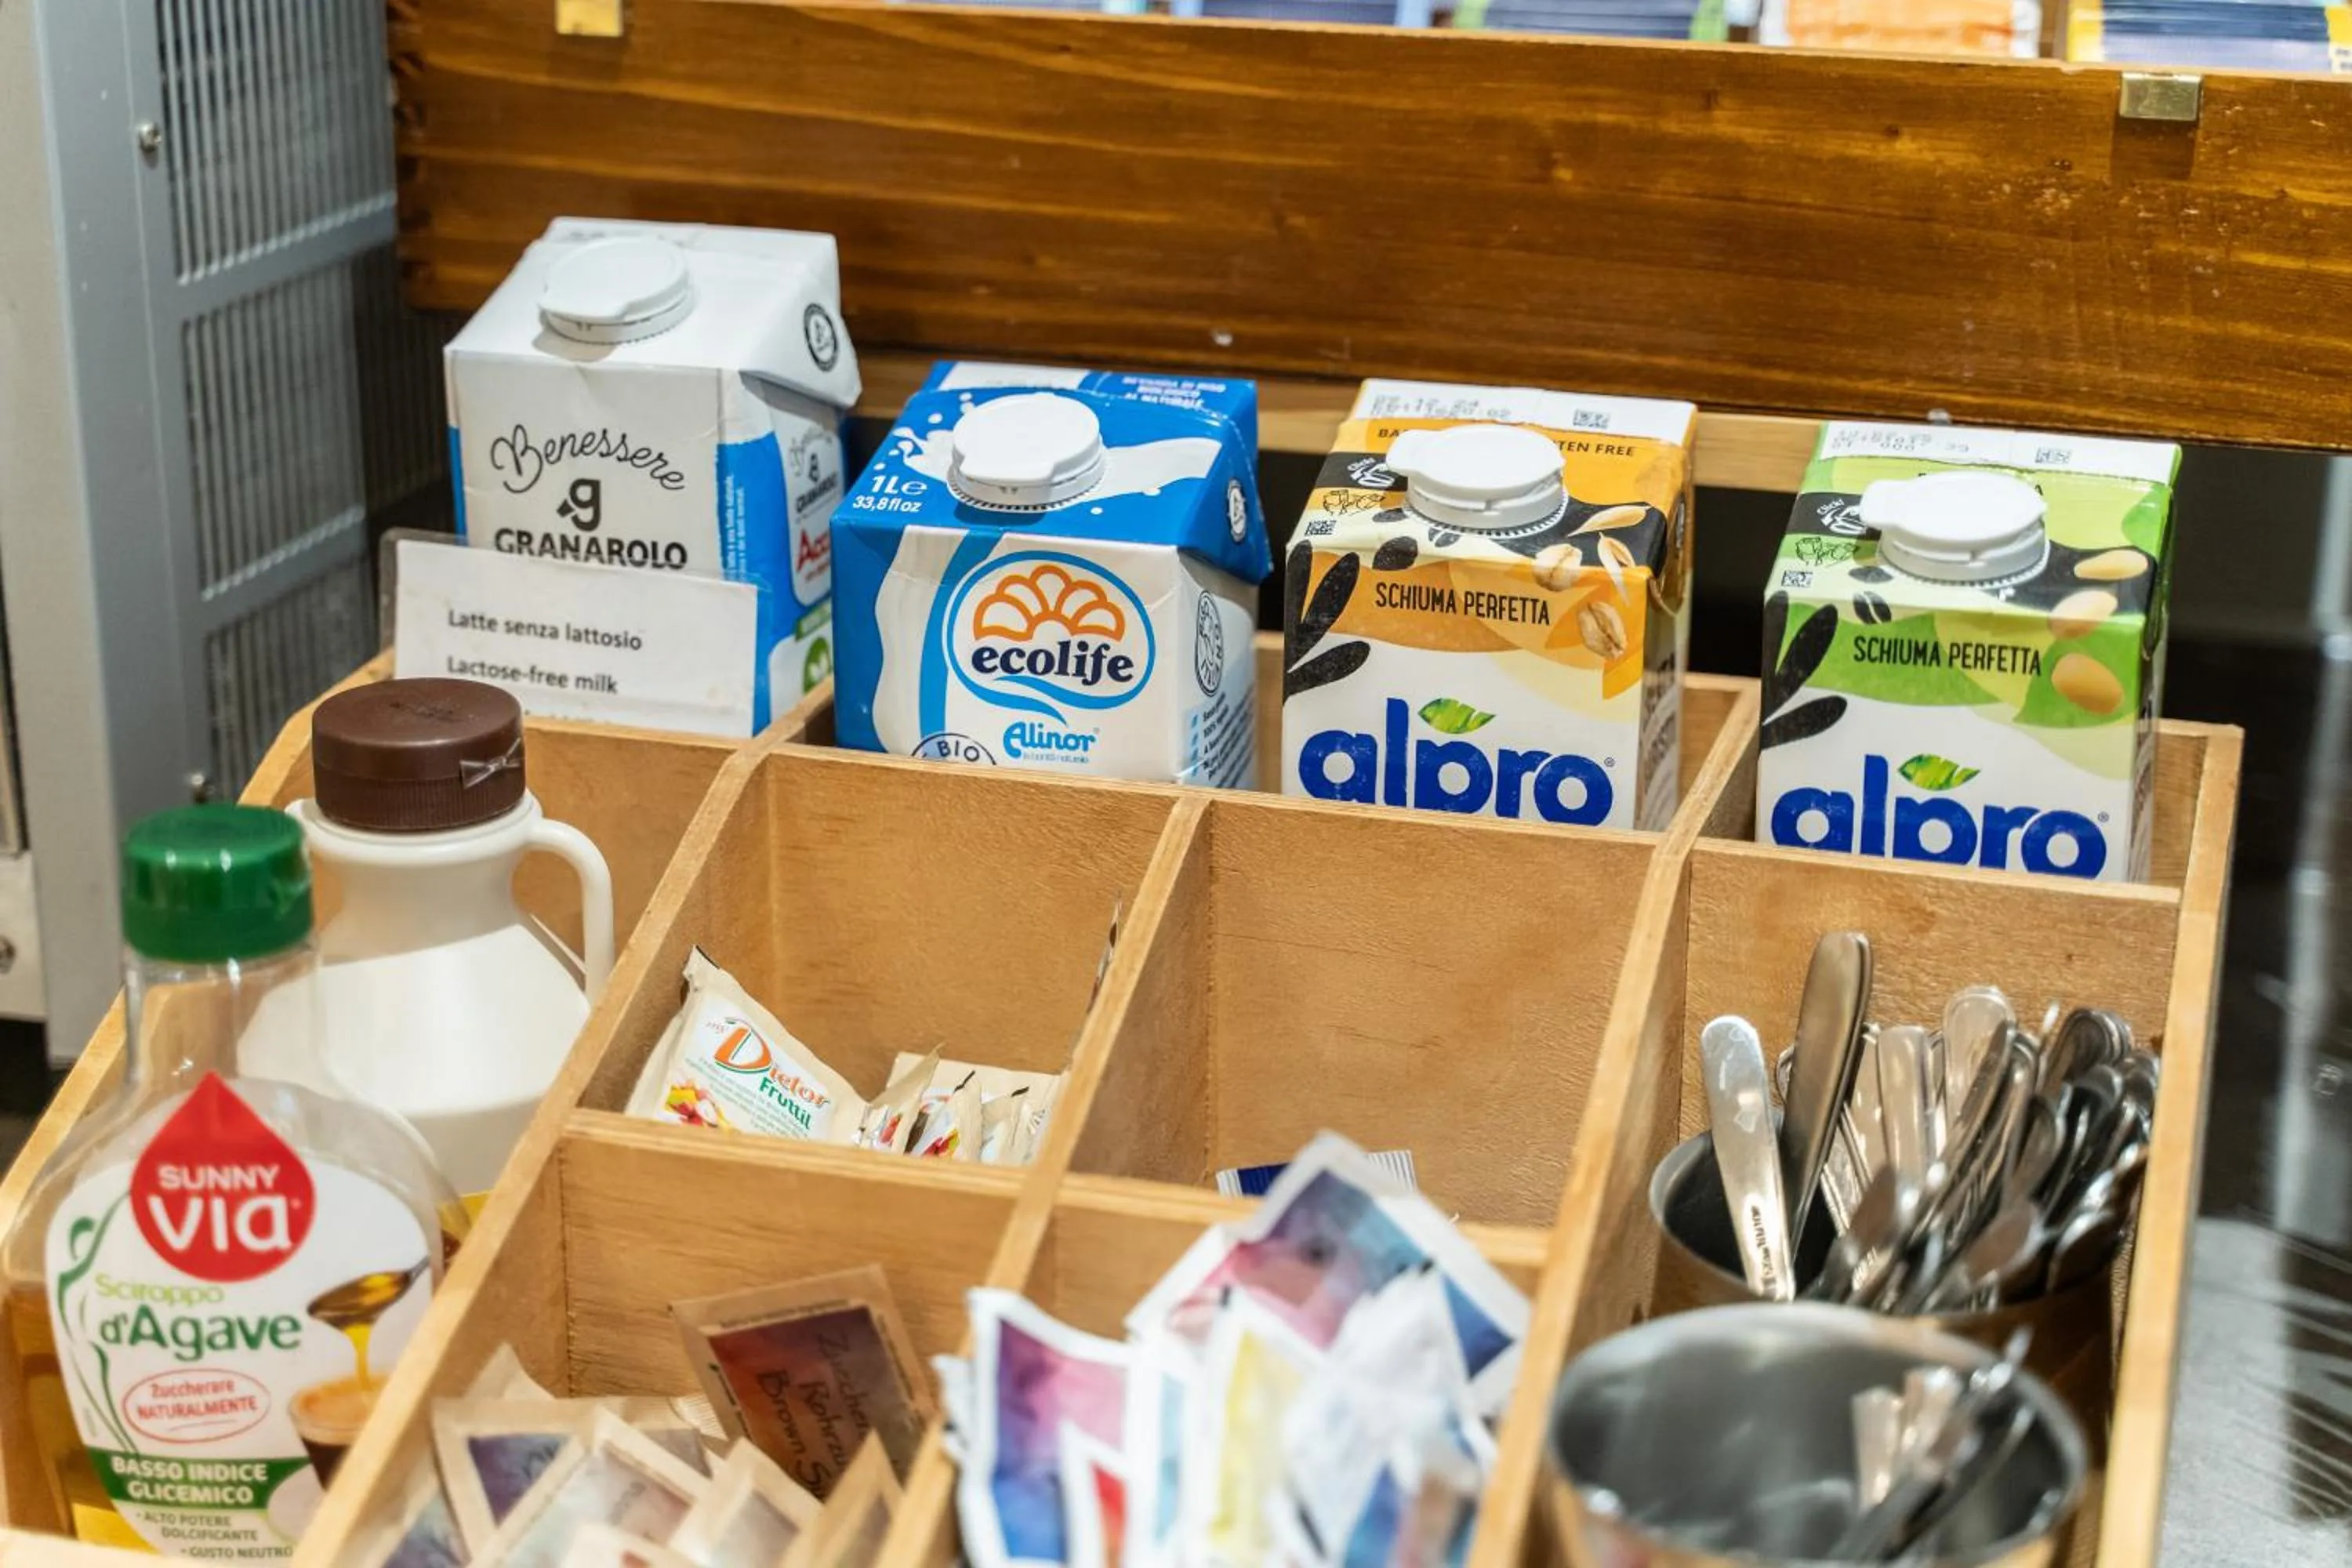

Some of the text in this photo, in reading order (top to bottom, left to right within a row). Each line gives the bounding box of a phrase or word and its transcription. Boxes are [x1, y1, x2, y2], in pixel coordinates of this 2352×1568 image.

[490, 423, 685, 493] Benessere
[1595, 443, 1637, 456] FREE
[495, 528, 688, 570] GRANAROLO
[1375, 582, 1550, 626] SCHIUMA PERFETTA
[448, 608, 643, 651] Latte senza lattosio
[447, 655, 619, 695] Lactose-free milk
[971, 640, 1134, 686] ecolife
[1853, 636, 2042, 677] SCHIUMA PERFETTA
[937, 740, 980, 763] BIO
[1003, 720, 1096, 758] Alinor
[1298, 698, 1613, 826] alpro
[1771, 753, 2107, 880] alpro
[158, 1163, 281, 1191] SUNNY
[94, 1273, 224, 1306] Sciroppo
[100, 1304, 302, 1362] d'Agave
[136, 1395, 258, 1420] NATURALMENTE
[757, 1369, 806, 1454] Brown
[111, 1456, 268, 1482] BASSO INDICE
[127, 1480, 255, 1504] GLICEMICO
[144, 1512, 231, 1527] ALTO POTERE
[161, 1527, 259, 1541] DOLCIFICANTE
[188, 1546, 234, 1559] GUSTO
